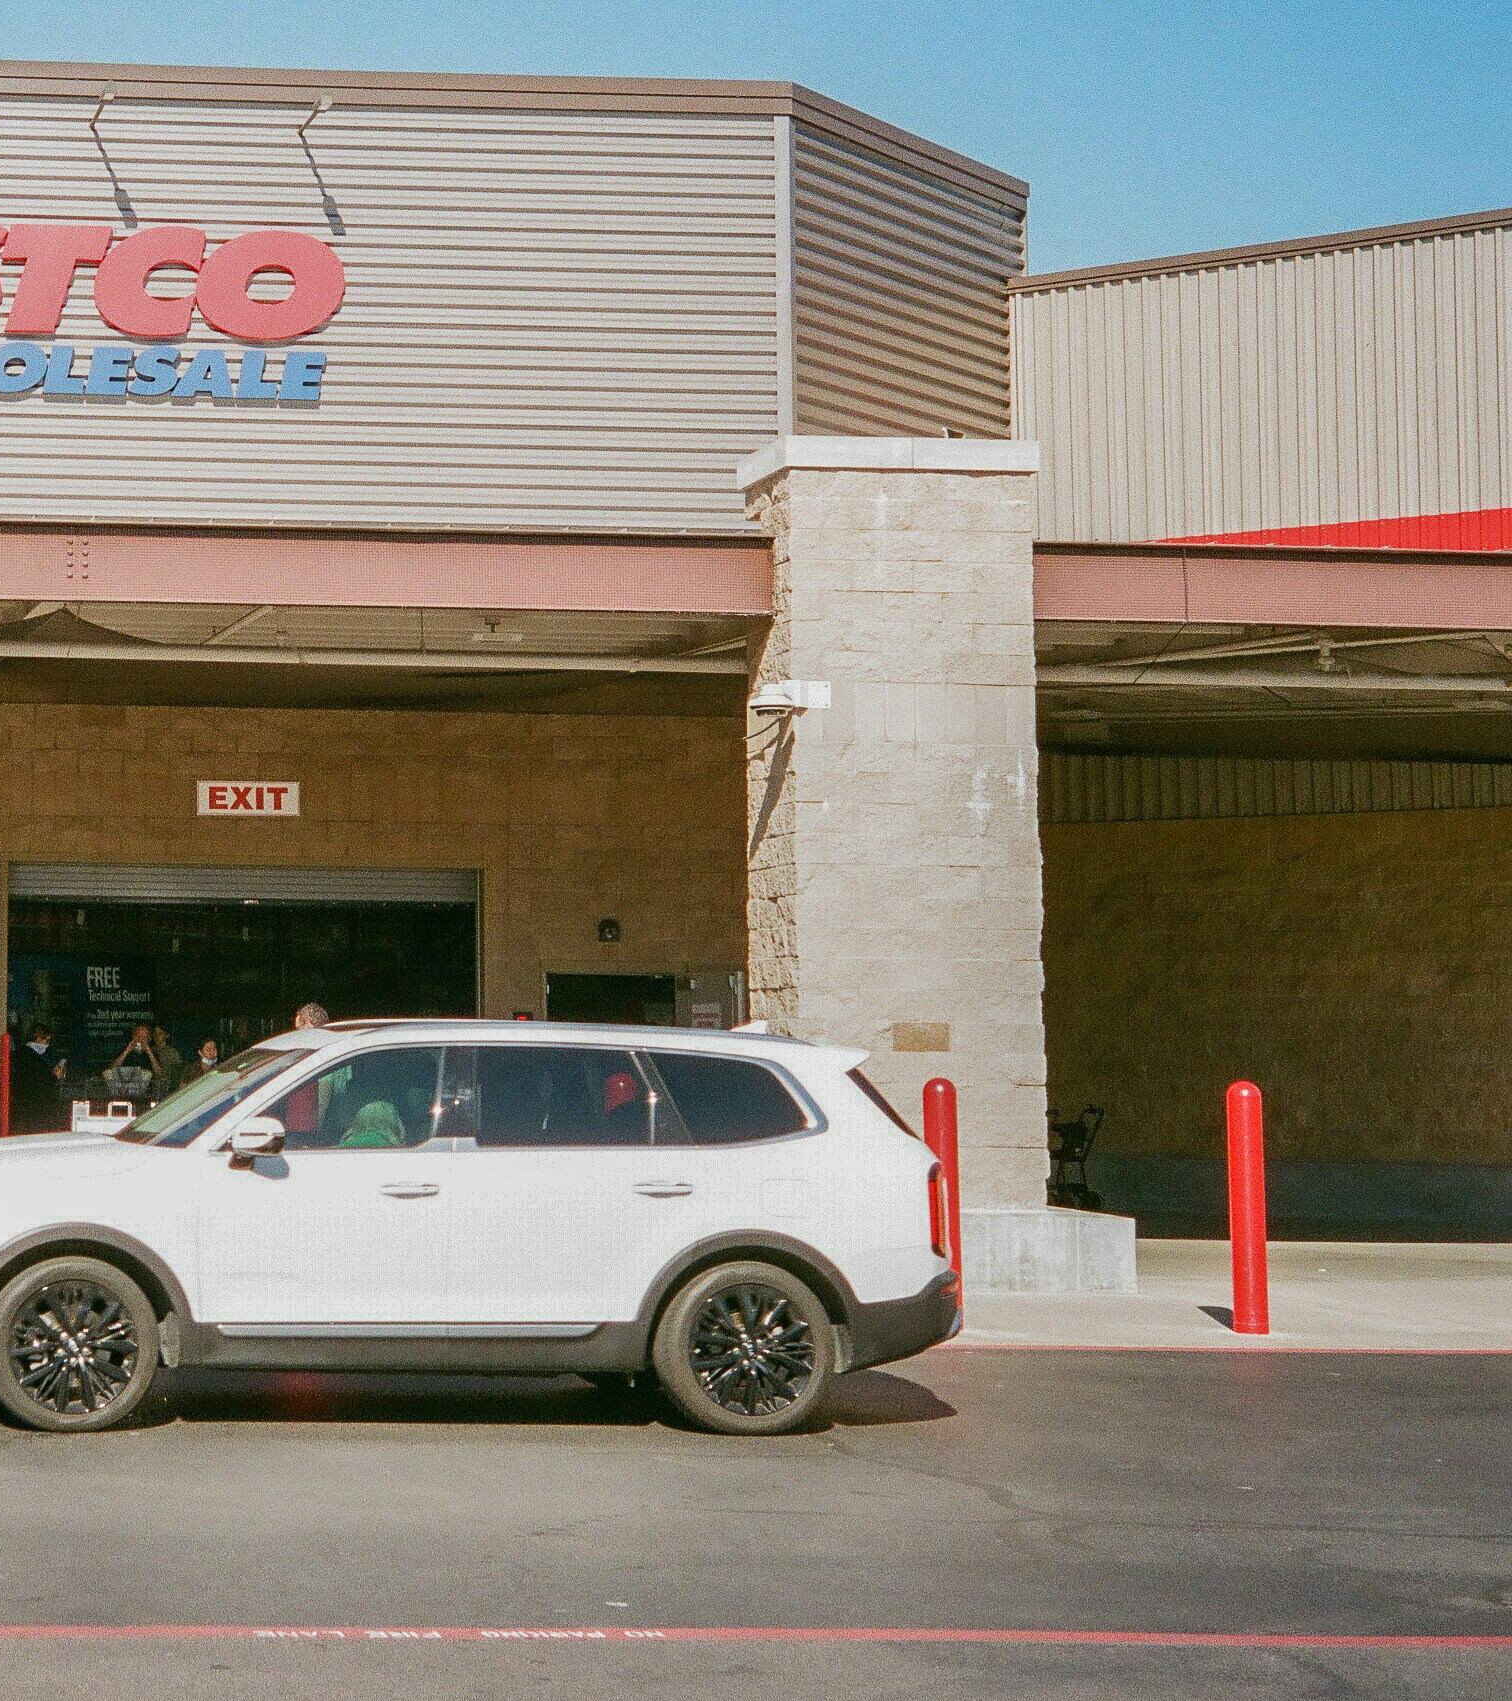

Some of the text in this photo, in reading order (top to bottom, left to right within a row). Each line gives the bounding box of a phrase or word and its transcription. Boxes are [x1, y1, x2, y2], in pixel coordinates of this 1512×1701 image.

[208, 786, 288, 810] EXIT
[87, 966, 120, 988] FREE
[88, 989, 151, 1004] Technical Support
[480, 1630, 607, 1639] PARKING
[624, 1630, 666, 1639] NO
